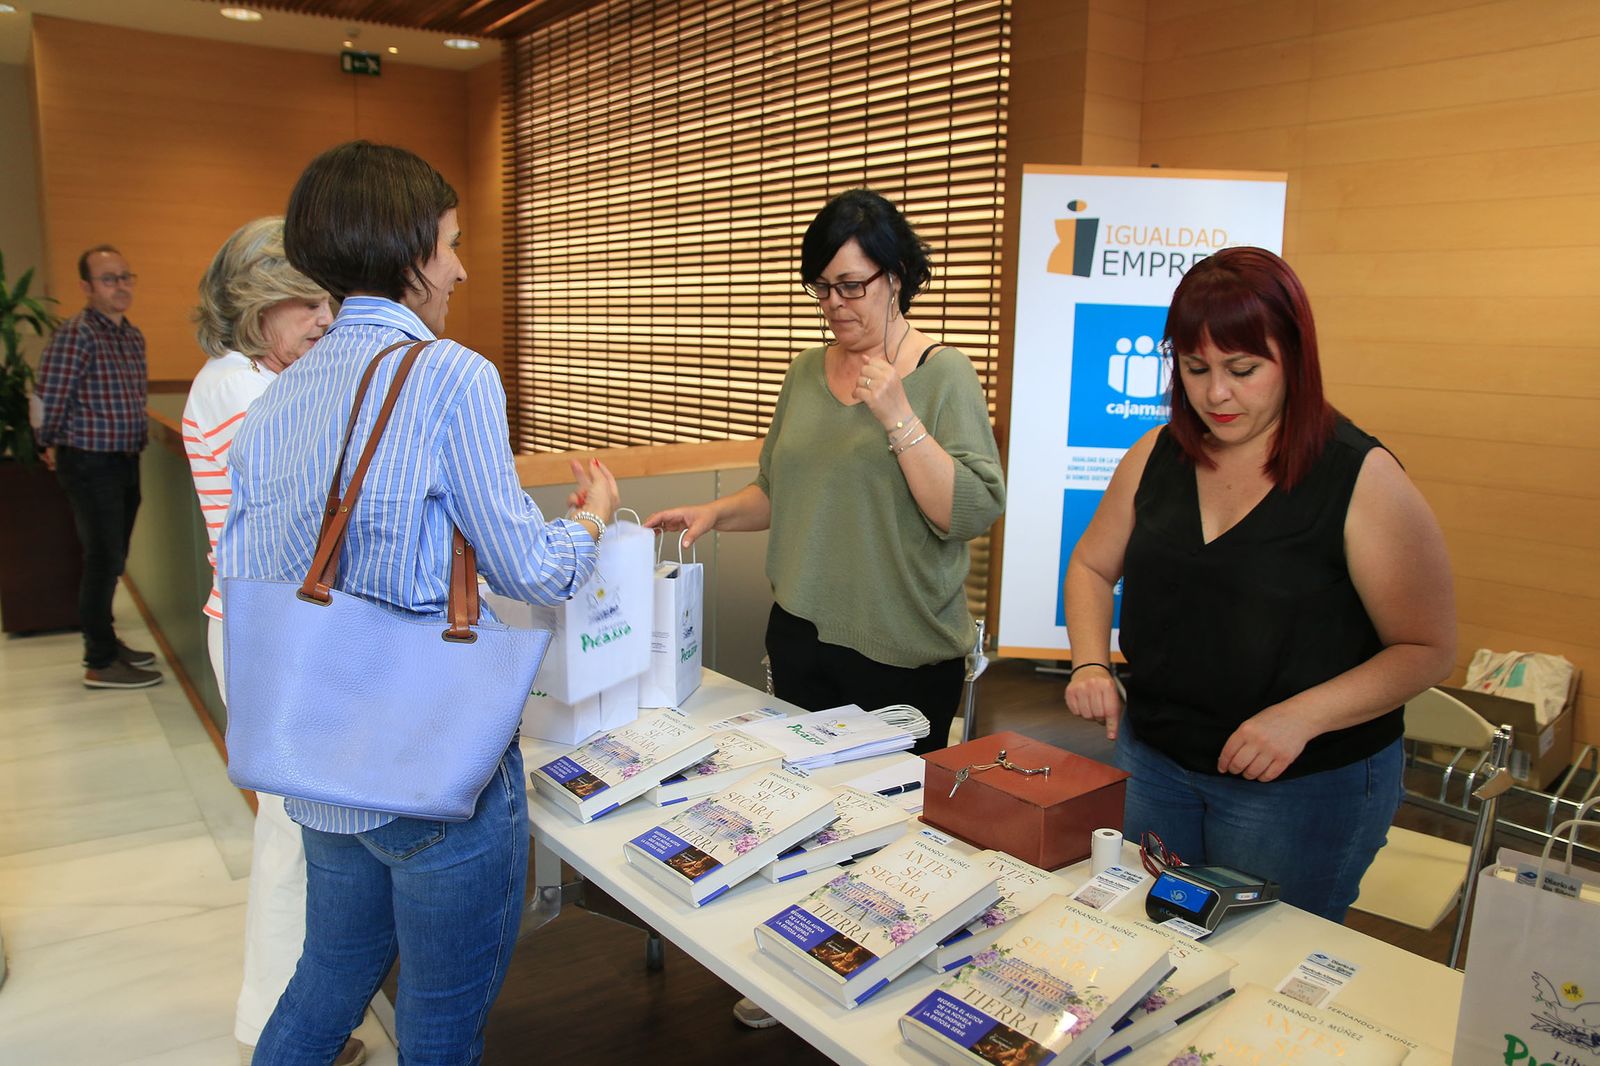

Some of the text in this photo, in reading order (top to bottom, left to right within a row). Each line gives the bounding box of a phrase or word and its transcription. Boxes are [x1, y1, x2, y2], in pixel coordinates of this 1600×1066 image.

[1105, 224, 1228, 247] IGUALDAD
[752, 791, 774, 803] SE
[753, 778, 801, 800] ANTES
[722, 791, 780, 820] SECARÁ
[672, 824, 719, 854] TIERRA
[914, 840, 944, 858] FERNANDO
[898, 849, 958, 880] ANTES
[900, 865, 928, 882] SE
[986, 861, 1039, 885] ANTES
[864, 864, 936, 904] SECARÁ
[812, 902, 871, 944] TIERRA
[844, 903, 869, 922] LA
[1065, 905, 1103, 924] FERNANDO
[1110, 923, 1138, 939] MÚÑEZ
[1052, 912, 1125, 952] ANTES
[1134, 921, 1170, 939] FERNANDO
[1001, 986, 1030, 1009] LA
[933, 1008, 943, 1017] QUE
[937, 997, 959, 1012] REGRESA
[964, 1011, 984, 1025] AUTOR
[951, 1011, 972, 1027] NOVELA
[963, 986, 1039, 1037] TIERRA
[1268, 999, 1318, 1023] FERNANDO
[1329, 1023, 1364, 1042] MÚÑEZ
[1328, 1006, 1375, 1030] FERNANDO
[930, 1014, 951, 1029] EXITOSA
[950, 1026, 967, 1038] SERIE
